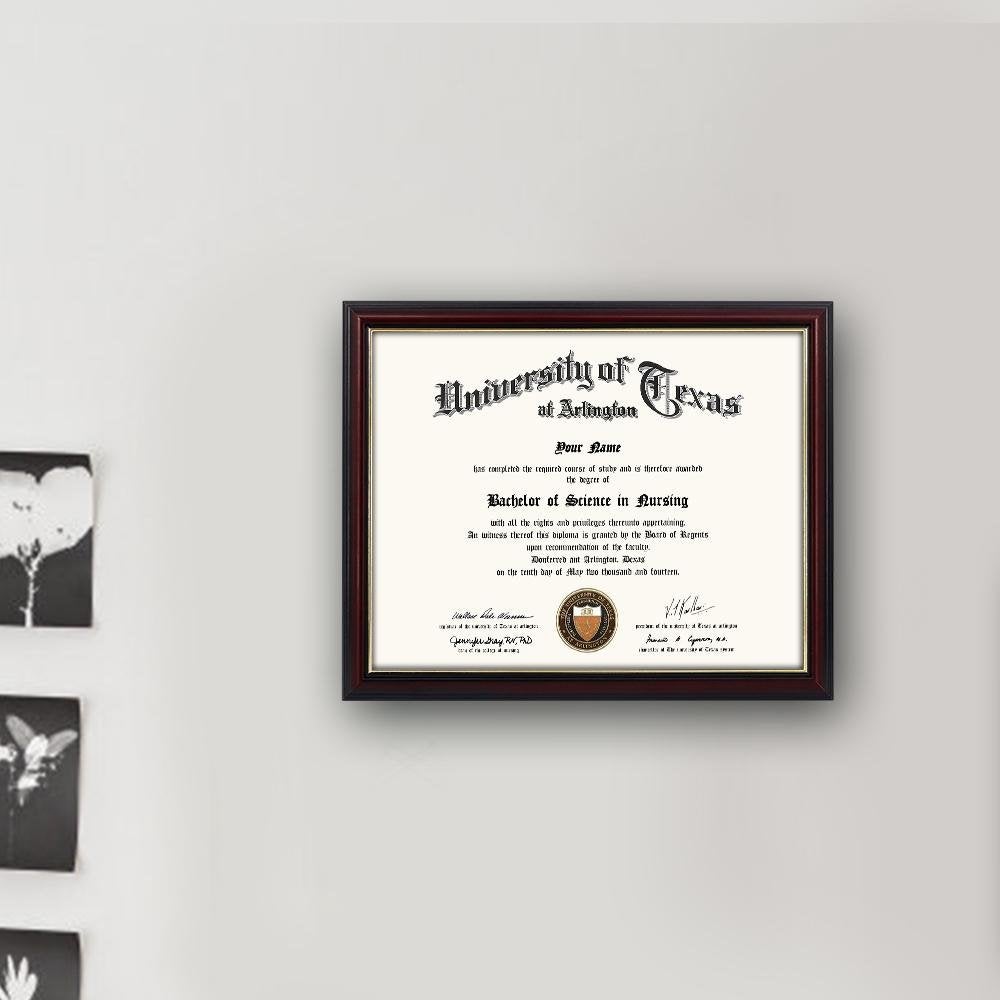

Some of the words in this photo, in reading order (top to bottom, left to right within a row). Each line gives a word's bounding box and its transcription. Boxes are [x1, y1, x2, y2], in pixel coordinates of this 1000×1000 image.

[433, 350, 594, 418] University
[598, 356, 636, 385] of
[638, 360, 744, 419] Texas
[538, 400, 554, 419] at
[557, 399, 638, 421] Arlington
[555, 441, 583, 455] Your
[587, 441, 621, 454] Name
[487, 494, 541, 508] Bachelor
[547, 494, 559, 506] of
[565, 494, 611, 506] Science
[618, 494, 628, 506] in
[635, 494, 688, 508] Nursing
